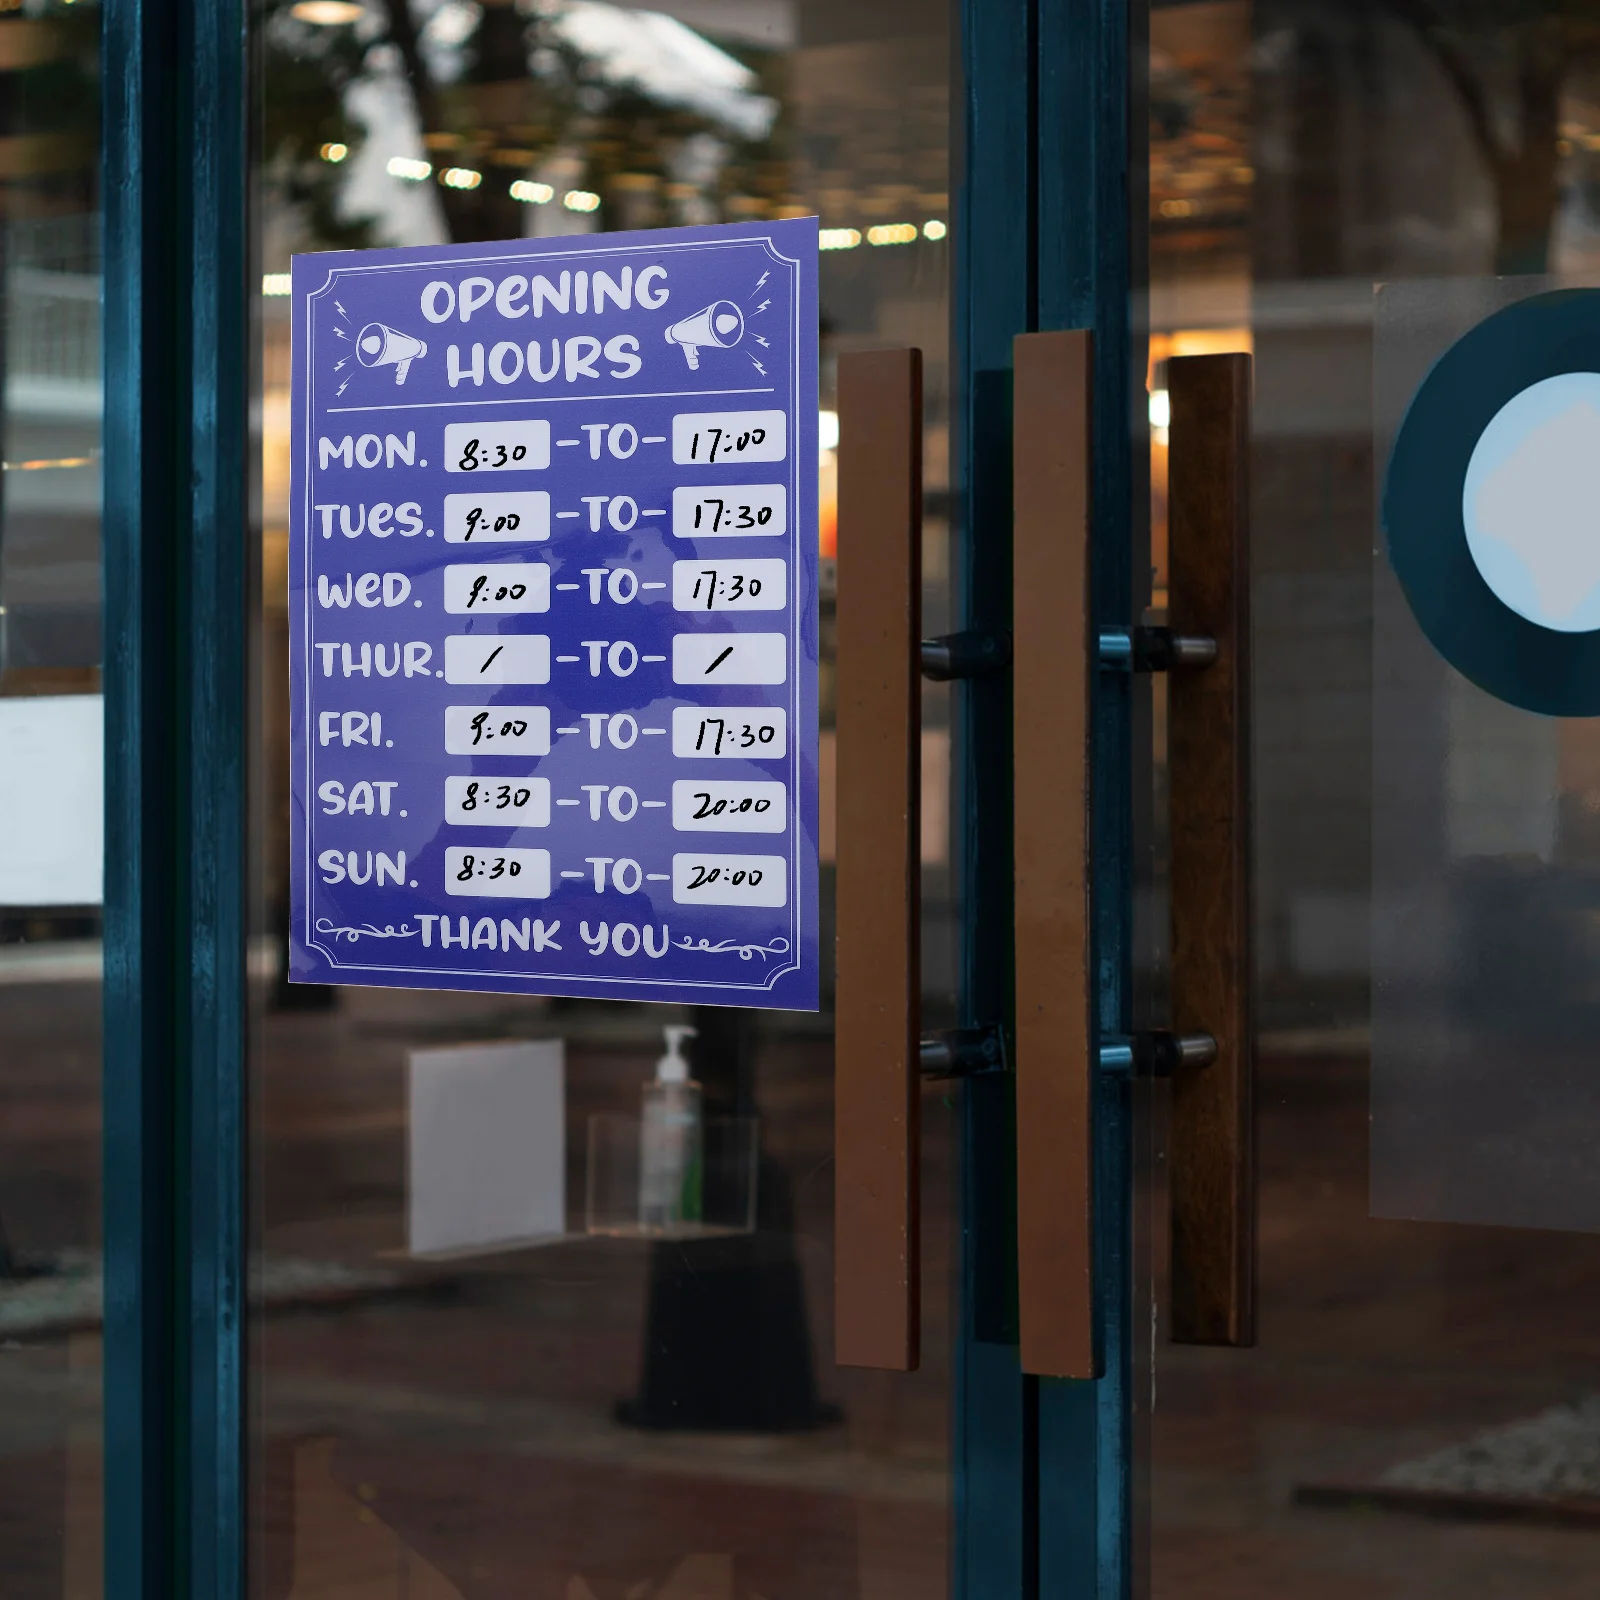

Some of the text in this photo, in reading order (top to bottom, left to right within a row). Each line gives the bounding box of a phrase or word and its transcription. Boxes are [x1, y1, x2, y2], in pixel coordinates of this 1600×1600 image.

[447, 335, 642, 387] HOURS
[319, 431, 427, 470] MON.
[459, 439, 526, 470] 8:30
[691, 429, 765, 462] 17:00
[465, 508, 520, 540] 9:00
[695, 499, 772, 532] 17:30
[467, 576, 526, 608] 9:00
[693, 571, 761, 608] 17:30
[315, 642, 443, 678] THUR.
[320, 711, 393, 747] FRI.
[470, 712, 527, 745] 9:00
[696, 719, 775, 755] 17:30
[318, 781, 407, 817] SAT.
[462, 783, 530, 810] 8:30
[693, 793, 770, 819] 20:00
[318, 850, 418, 887] SUN.
[457, 855, 521, 881] 8:30
[687, 866, 762, 889] 20:00
[414, 915, 562, 952] THANK
